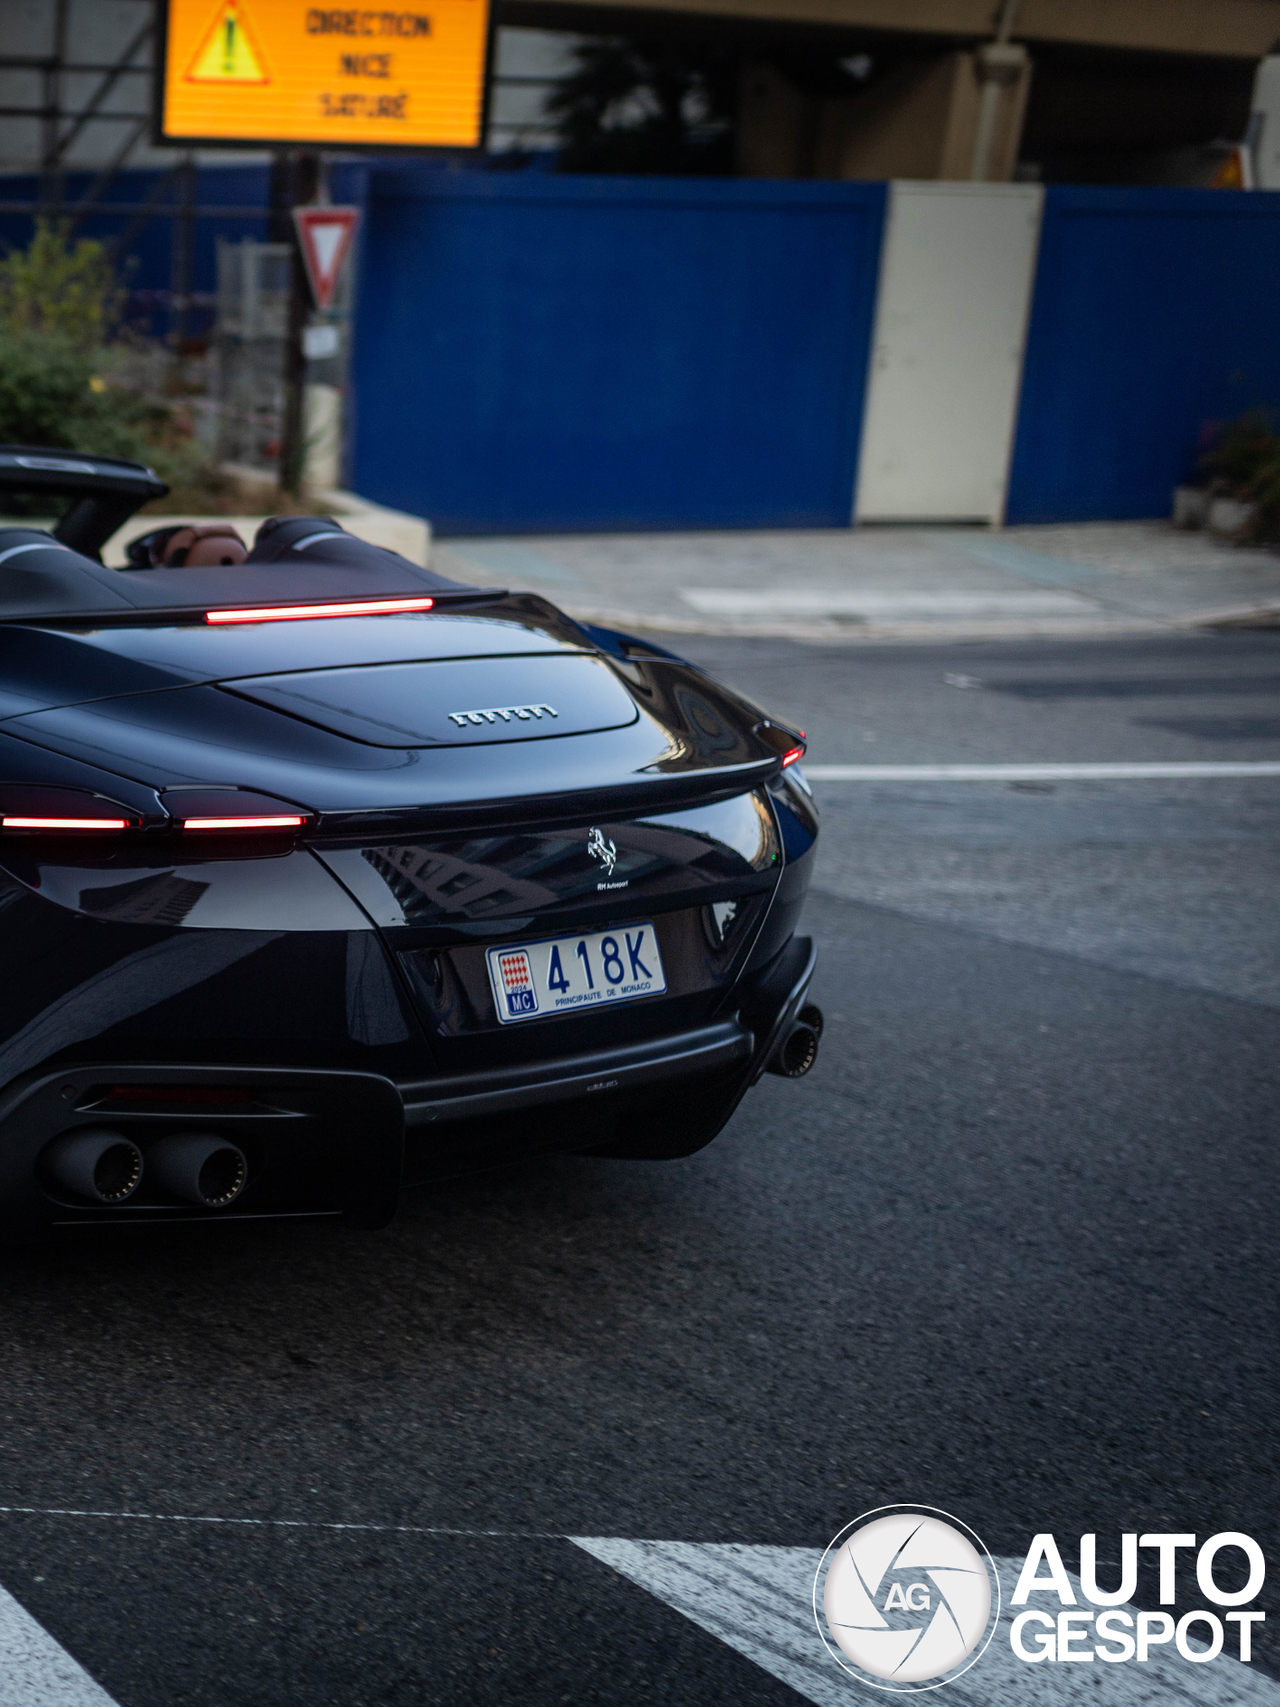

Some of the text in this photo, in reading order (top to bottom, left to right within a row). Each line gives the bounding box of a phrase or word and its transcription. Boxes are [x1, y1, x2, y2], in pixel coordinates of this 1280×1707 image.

[305, 8, 433, 37] DIRECTION
[338, 52, 393, 79] NICE
[448, 703, 558, 727] Ferrari
[547, 930, 653, 994] 418K
[510, 984, 527, 994] 2024
[555, 981, 651, 1007] PRINCIPAUTE DE MONACO
[511, 994, 531, 1011] MC
